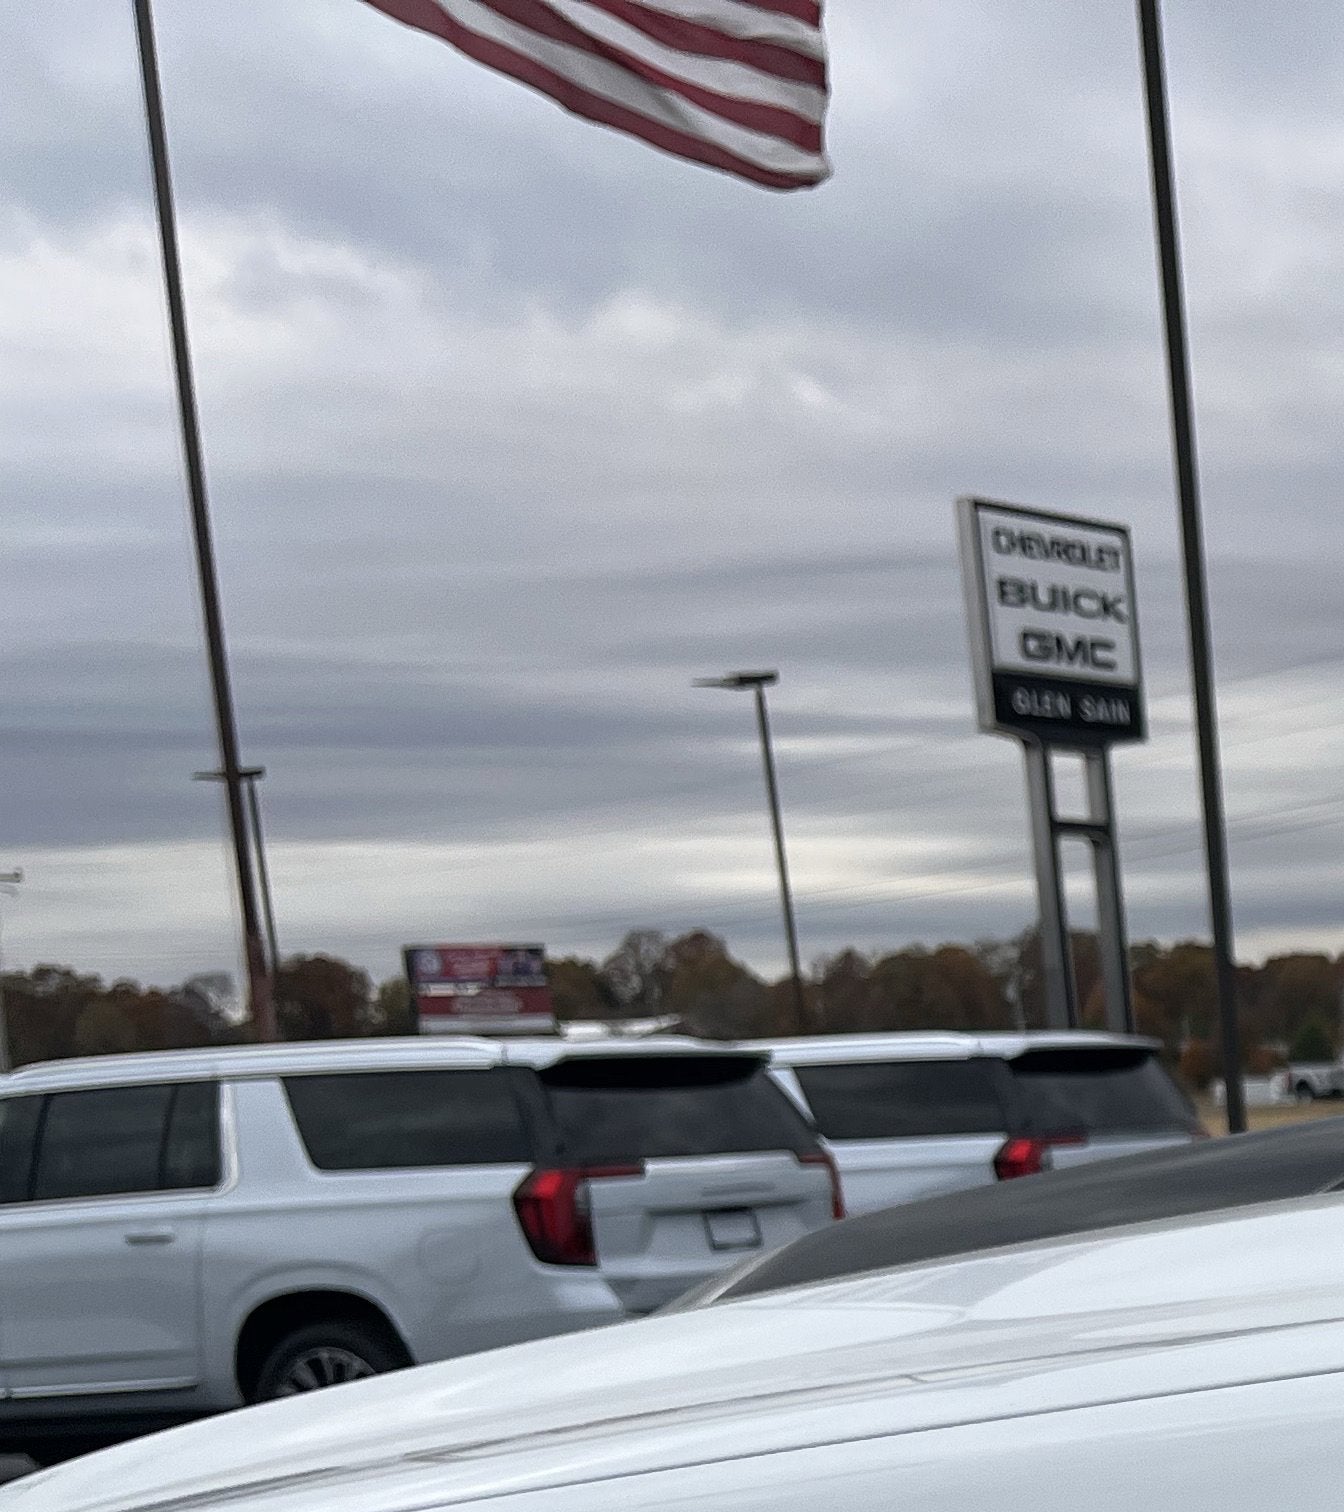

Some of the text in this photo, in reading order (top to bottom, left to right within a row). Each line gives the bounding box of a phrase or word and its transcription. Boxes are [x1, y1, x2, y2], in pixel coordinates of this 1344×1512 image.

[997, 576, 1128, 625] BUICK
[1019, 627, 1117, 671] GMC
[1012, 686, 1131, 726] GLEN SAIN
